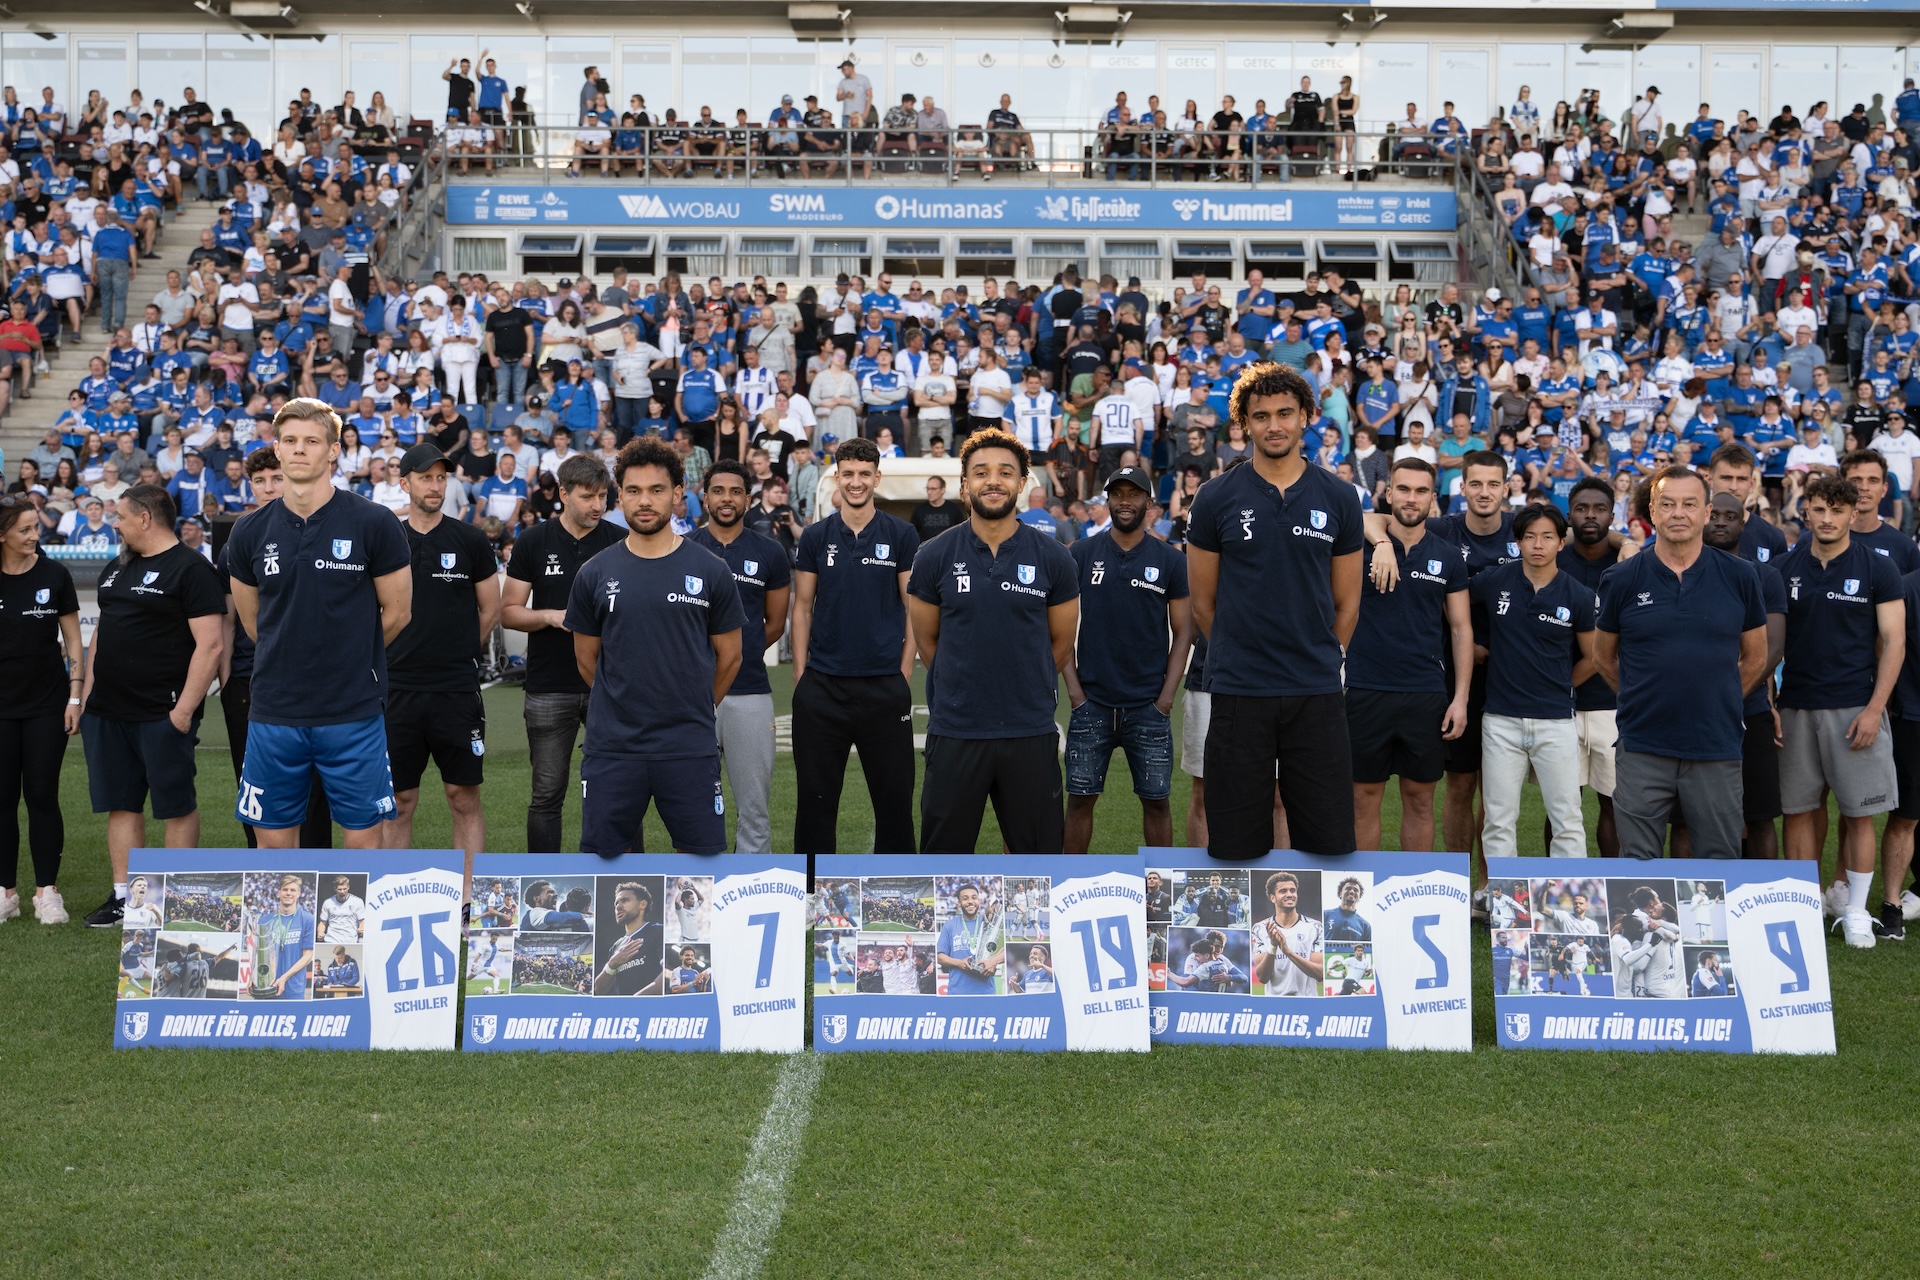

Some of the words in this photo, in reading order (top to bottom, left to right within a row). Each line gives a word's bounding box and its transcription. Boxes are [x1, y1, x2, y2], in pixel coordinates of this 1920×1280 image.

[1108, 57, 1140, 67] GETEC
[1175, 58, 1208, 67] GETEC
[1243, 59, 1276, 68] GETEC
[1311, 59, 1344, 69] GETEC
[498, 195, 530, 205] REWE
[769, 194, 825, 212] SWM
[902, 198, 1003, 219] Humanas
[1406, 197, 1431, 208] intel
[669, 202, 740, 218] WOBAU
[787, 213, 843, 221] MAGDEBURG
[1203, 199, 1293, 221] hummel
[1399, 214, 1432, 223] GETEC
[1107, 404, 1130, 428] 20
[264, 556, 280, 576] 26
[326, 560, 365, 571] Humanas
[545, 565, 563, 576] A.K.
[956, 576, 970, 593] 19
[1091, 570, 1105, 585] 27
[1011, 584, 1046, 598] Humanas
[1834, 592, 1868, 604] Humanas
[1496, 601, 1510, 616] 37
[238, 780, 265, 821] 26
[369, 901, 378, 911] 1.
[379, 889, 394, 903] FC
[394, 882, 462, 901] MAGDEBURG
[713, 901, 722, 912] 1.
[722, 892, 738, 906] FC
[739, 882, 806, 901] MAGDEBURG
[1054, 903, 1064, 914] 1.
[1063, 894, 1078, 907] FC
[1078, 885, 1144, 905] MAGDEBURG
[1376, 901, 1385, 912] 1.
[1384, 893, 1400, 906] FC
[1400, 884, 1468, 903] MAGDEBURG
[1730, 908, 1741, 919] 1.
[1739, 899, 1754, 913] FC
[1755, 891, 1821, 911] MAGDEBURG
[381, 911, 456, 993] 26
[748, 912, 781, 989] 7
[1070, 915, 1138, 992] 19
[1412, 914, 1449, 990] 5
[1764, 920, 1810, 994] 9
[617, 957, 645, 972] umanas
[394, 996, 449, 1014] SCHULER
[733, 998, 797, 1017] BOCKHORN
[1083, 1000, 1113, 1015] BELL
[1114, 997, 1144, 1012] BELL
[1402, 998, 1468, 1016] LAWRENCE
[1760, 1001, 1833, 1020] CASTAIGNOS
[160, 1015, 216, 1037] DANKE
[216, 1010, 248, 1037] FÜR
[249, 1014, 298, 1039] ALLES,
[302, 1014, 351, 1037] LUCA!
[503, 1017, 559, 1040] DANKE
[558, 1012, 592, 1039] FÜR
[592, 1017, 641, 1042] ALLES,
[645, 1017, 709, 1039] HERBIE!
[855, 1017, 912, 1040] DANKE
[913, 1012, 947, 1039] FÜR
[949, 1017, 999, 1042] ALLES,
[1003, 1016, 1050, 1039] LEON!
[1176, 1011, 1232, 1034] DANKE
[1233, 1008, 1263, 1035] FÜR
[1264, 1013, 1311, 1039] ALLES,
[1315, 1015, 1372, 1038] JAMIE!
[1543, 1016, 1600, 1039] DANKE
[1601, 1011, 1635, 1040] FÜR
[1637, 1017, 1690, 1043] ALLES,
[1694, 1018, 1733, 1041] LUC!
